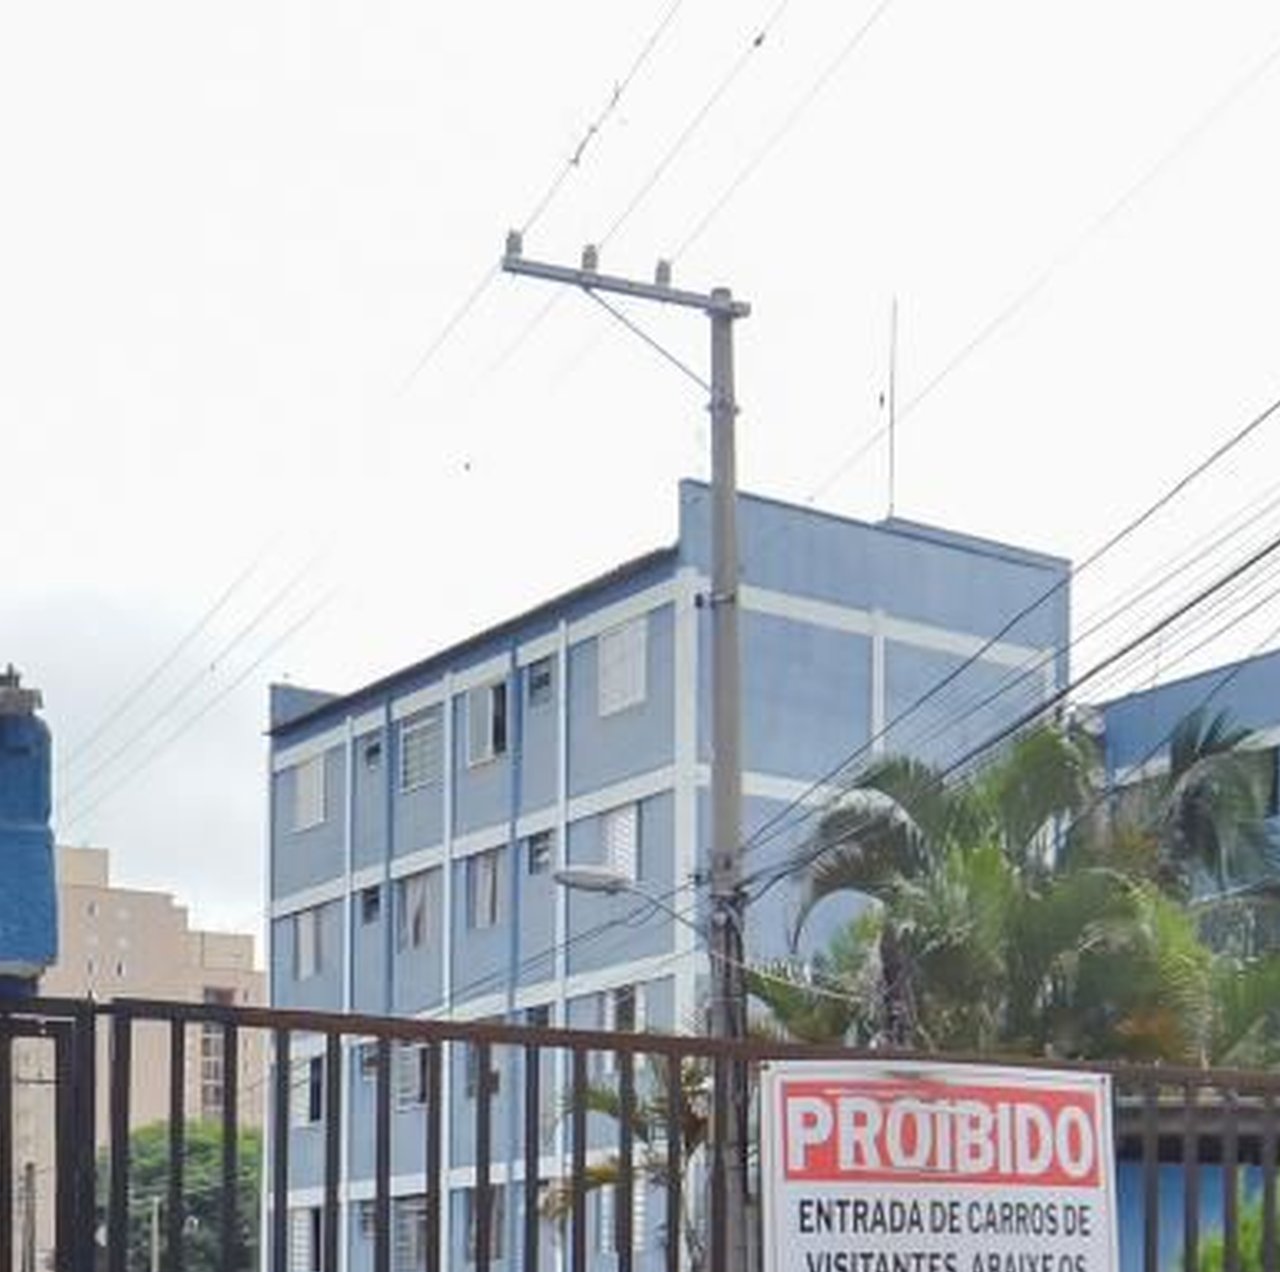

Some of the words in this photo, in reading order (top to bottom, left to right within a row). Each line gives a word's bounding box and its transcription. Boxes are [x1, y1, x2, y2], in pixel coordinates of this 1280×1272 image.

[787, 1095, 1094, 1178] PROIBIDO
[799, 1199, 923, 1234] ENTRADA
[930, 1202, 960, 1234] DE
[968, 1203, 1058, 1236] CARROS
[1065, 1205, 1091, 1237] DE
